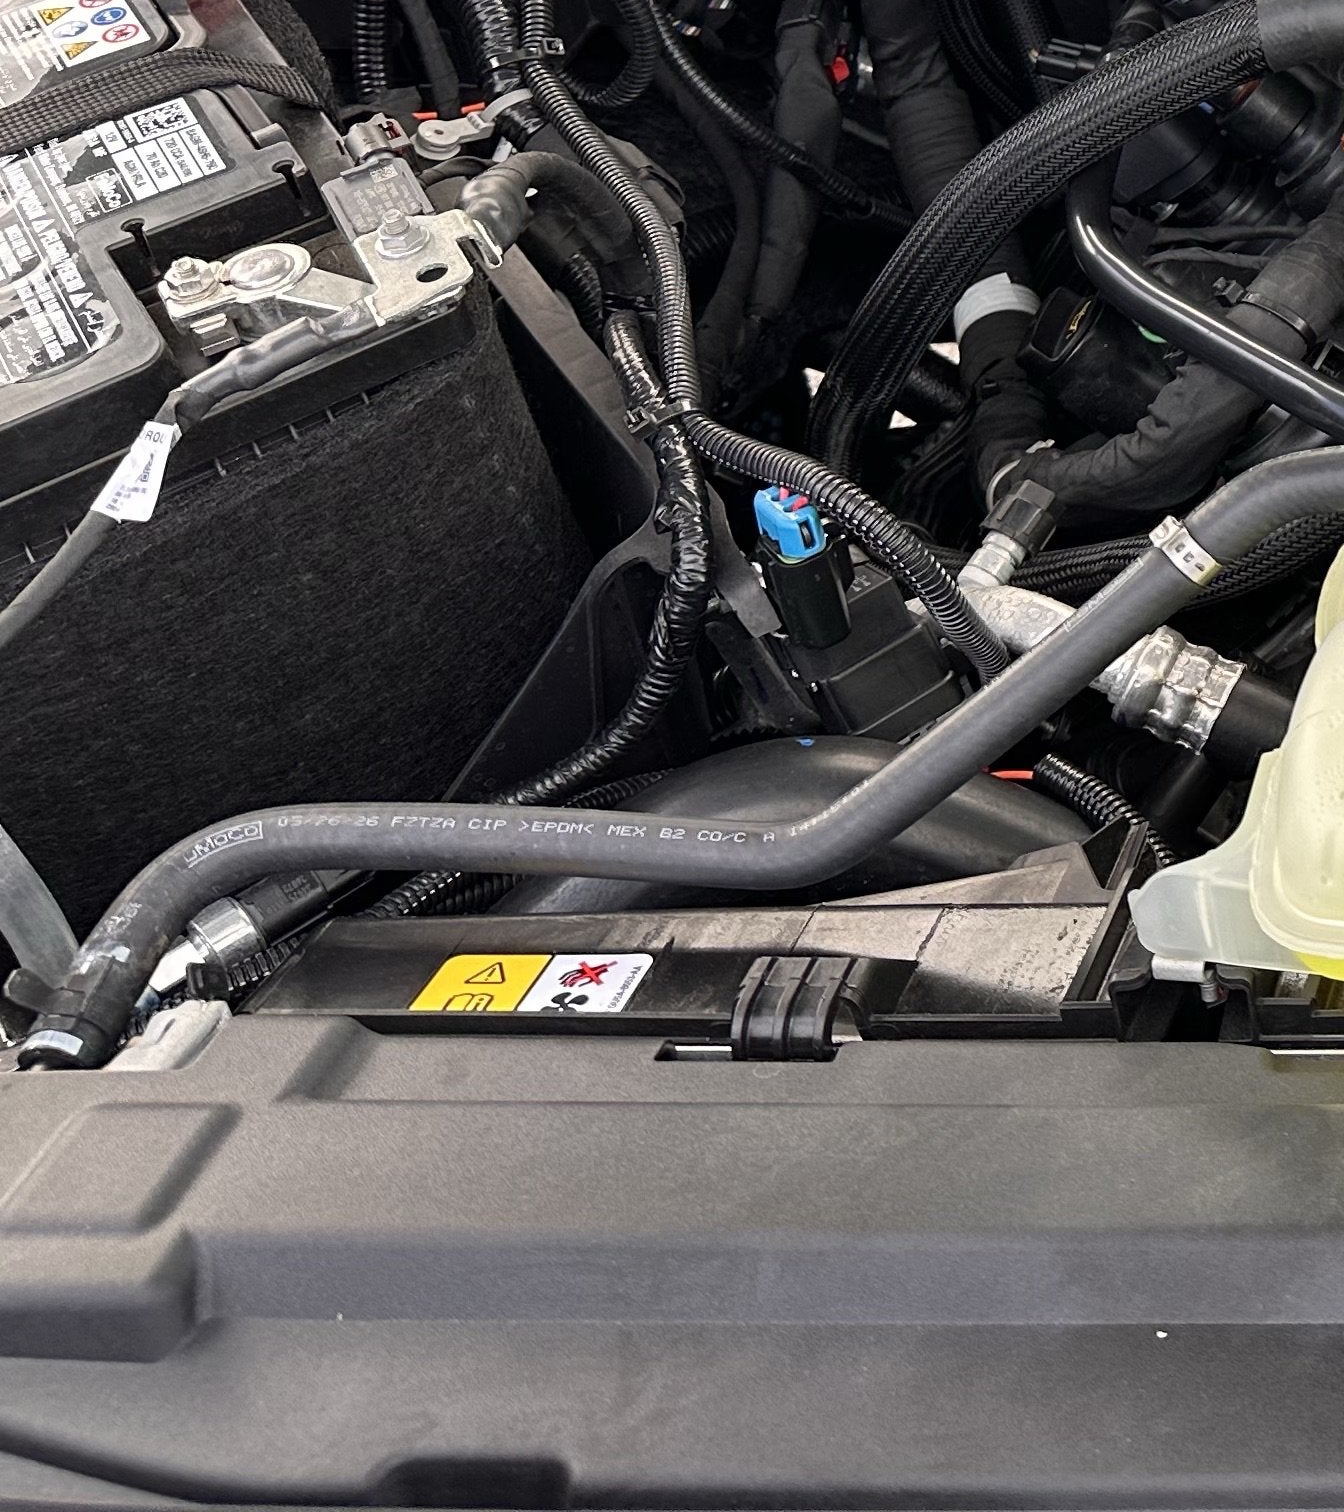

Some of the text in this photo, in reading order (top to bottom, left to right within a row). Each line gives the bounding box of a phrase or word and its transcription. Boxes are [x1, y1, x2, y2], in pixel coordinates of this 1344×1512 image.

[467, 819, 507, 831] CIP
[518, 820, 594, 835] >EPDM<
[607, 824, 646, 838] MEX
[659, 827, 685, 840] B2
[763, 831, 776, 843] A
